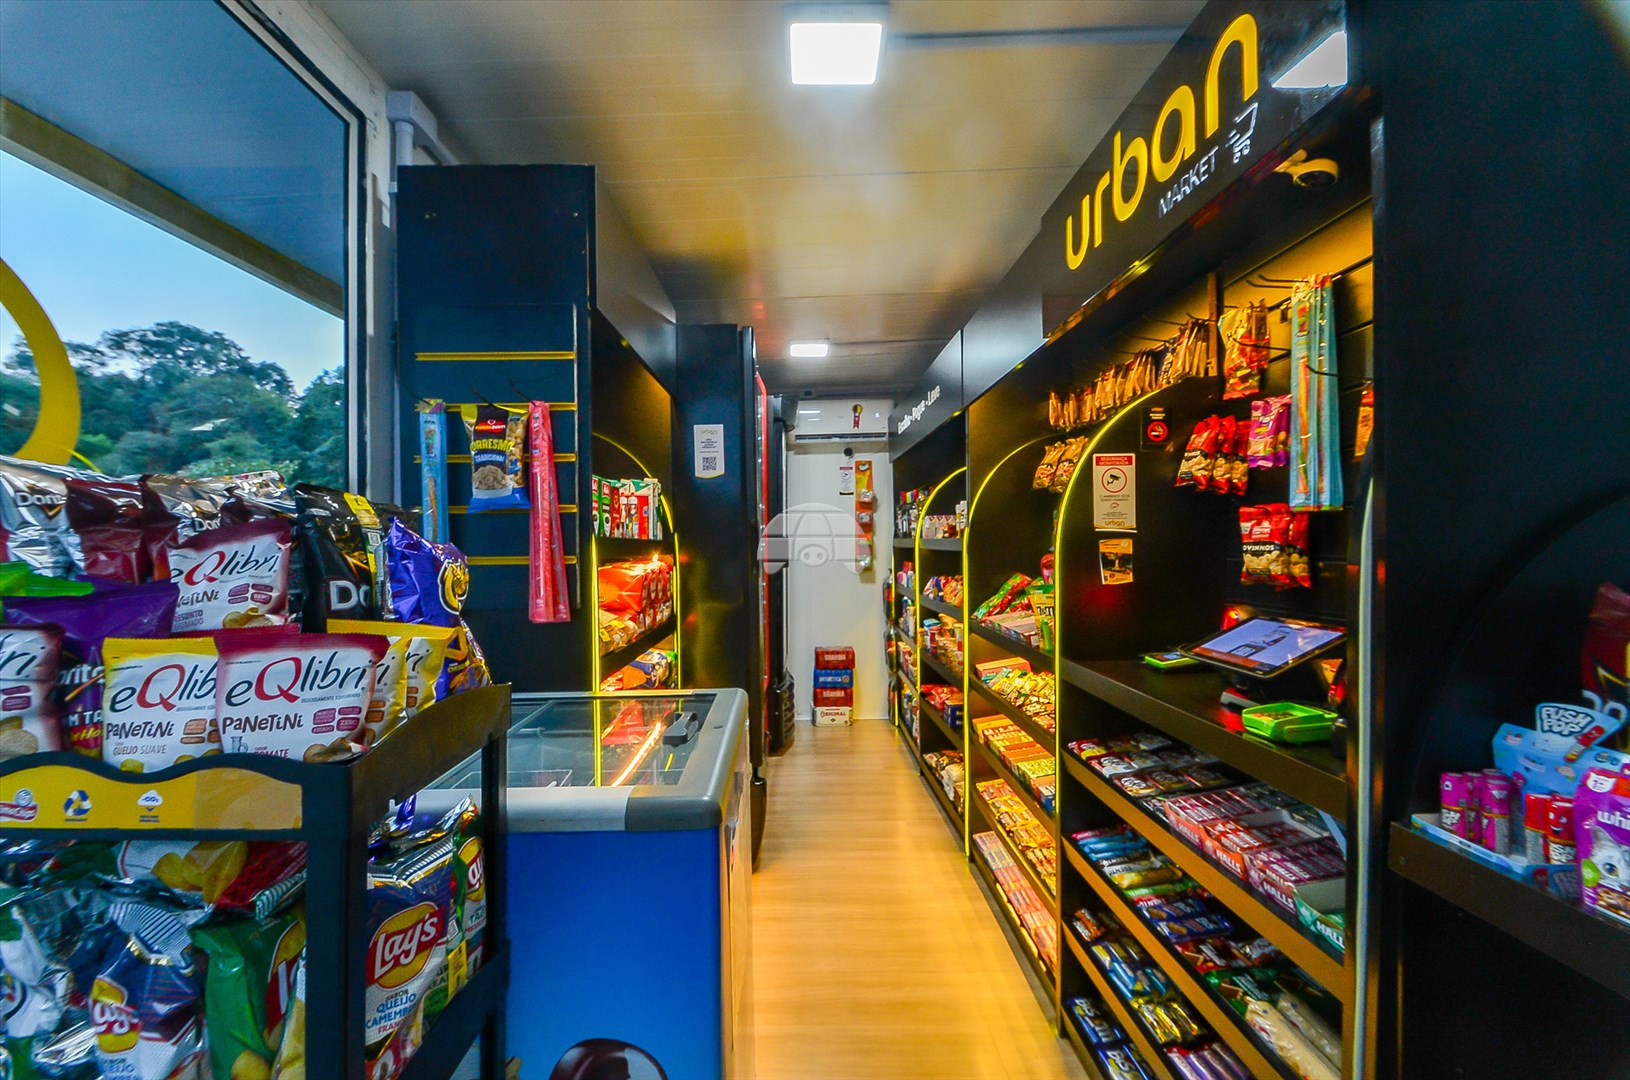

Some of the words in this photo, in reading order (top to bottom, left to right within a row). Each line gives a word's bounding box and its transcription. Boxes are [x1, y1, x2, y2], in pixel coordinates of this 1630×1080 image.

[1066, 13, 1259, 270] urban
[1158, 146, 1219, 218] MARKET
[471, 438, 514, 452] ORRESMO
[109, 656, 216, 713] eQlib
[225, 651, 371, 707] eQlibri
[1541, 707, 1592, 728] PUSH
[1543, 719, 1580, 735] POP
[1179, 824, 1200, 843] HALLS
[1216, 848, 1241, 873] HALLS
[1262, 881, 1294, 910] HALLS
[374, 913, 438, 980] Lay's
[1316, 920, 1345, 950] HALL
[377, 993, 416, 1013] QUEIJO
